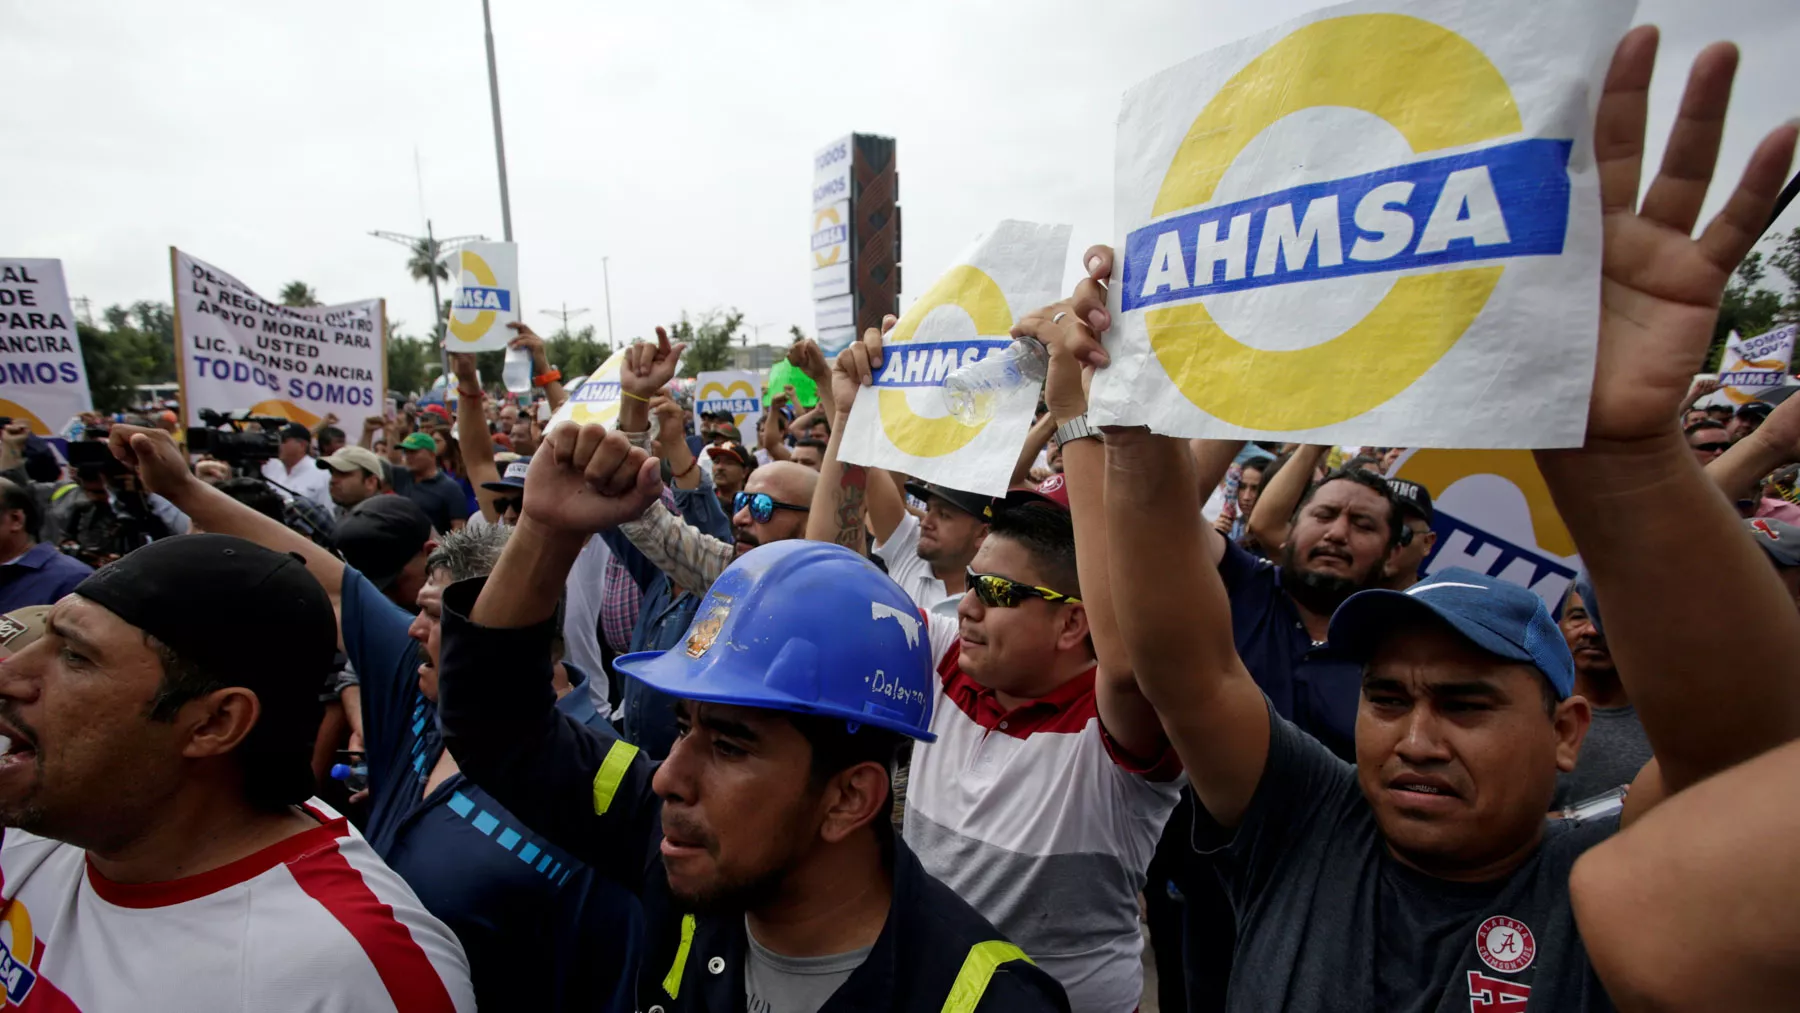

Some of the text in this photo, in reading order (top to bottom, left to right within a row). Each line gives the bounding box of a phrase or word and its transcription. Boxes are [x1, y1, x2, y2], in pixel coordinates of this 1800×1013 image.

[815, 143, 847, 172] TODOS
[813, 176, 846, 203] SOMOS
[1139, 164, 1511, 298] AHMSA
[0, 289, 37, 306] DE
[192, 280, 210, 297] LA
[0, 312, 67, 330] PARA
[197, 300, 256, 329] APOYO
[262, 319, 371, 349] MORAL PARA
[1744, 327, 1795, 351] SOMOS
[257, 335, 320, 358] USTED
[194, 336, 373, 382] LIC. ALONSO ANCIRA
[193, 356, 373, 407] TODOS SOMOS
[575, 384, 620, 401] AHM
[702, 400, 754, 414] AHMSA
[1480, 918, 1529, 939] ALABAMA
[1480, 946, 1533, 970] CRIMSON TIDE
